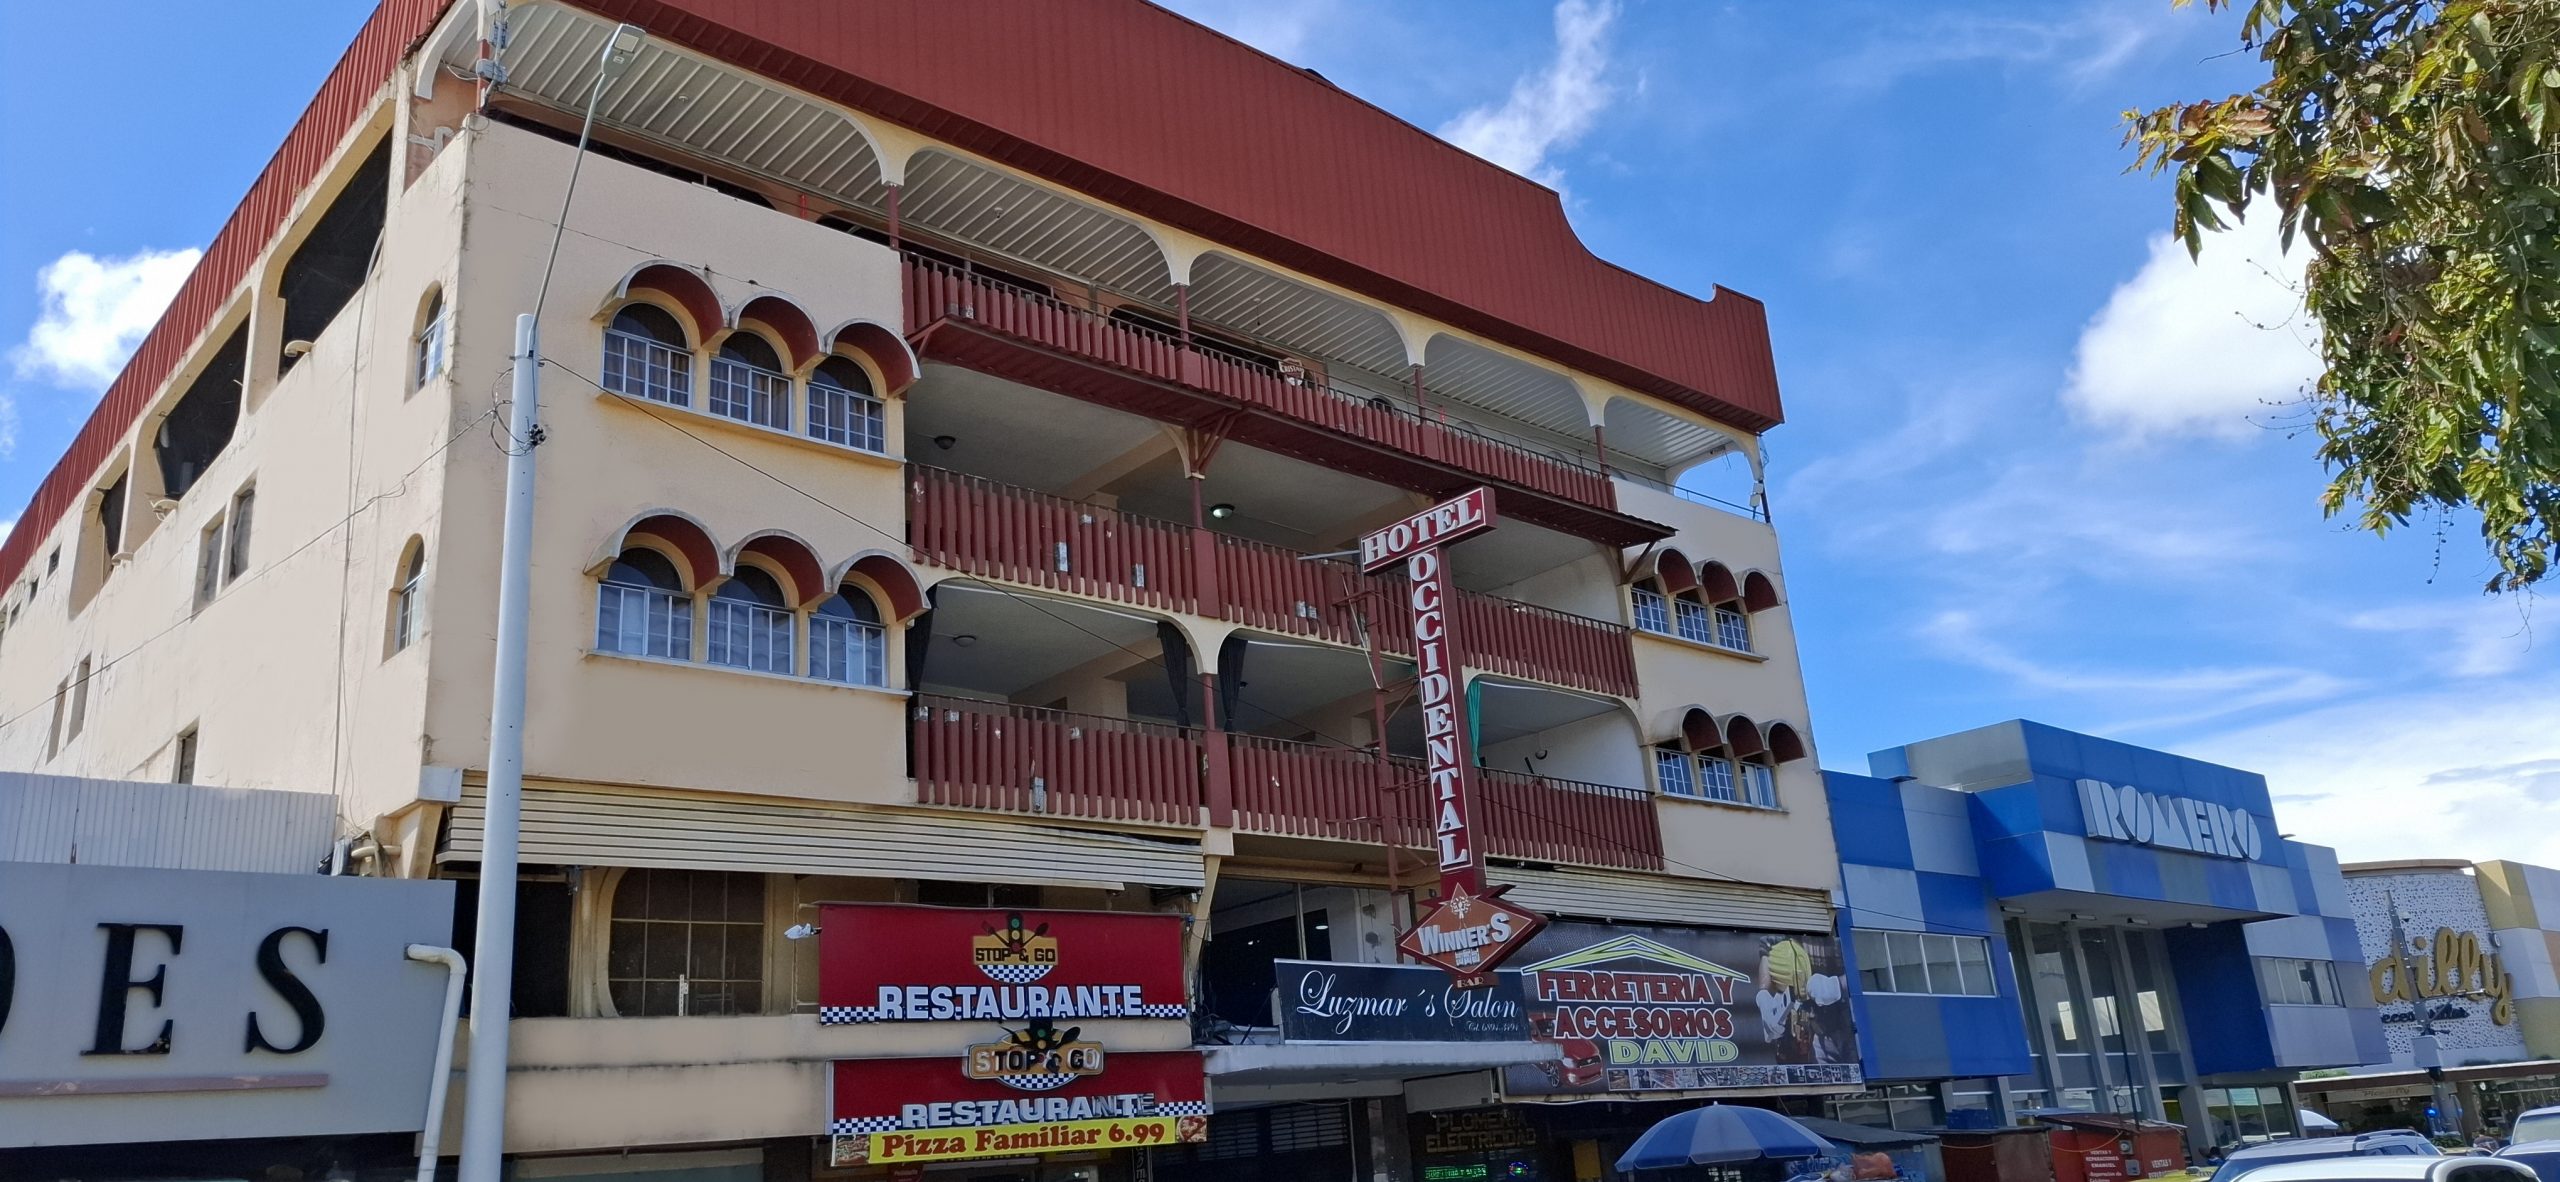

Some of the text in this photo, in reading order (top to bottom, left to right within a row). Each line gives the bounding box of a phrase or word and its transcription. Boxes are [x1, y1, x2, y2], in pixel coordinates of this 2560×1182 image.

[1361, 497, 1481, 565] HOTEL
[1410, 552, 1467, 867] OCCIDENTAL
[2076, 779, 2261, 861] ROMERO
[975, 947, 1056, 963] STOP & GO
[0, 921, 329, 1056] ES
[1456, 976, 1484, 989] BAR
[1537, 970, 1735, 1004] FERRETERIA Y
[877, 985, 1143, 1020] RESTAURANTE
[1297, 970, 1408, 1034] Luzmar
[1444, 984, 1519, 1026] Salon
[1554, 1006, 1735, 1039] ACCESORIOS
[975, 1047, 1036, 1072] STOP
[1067, 1048, 1101, 1071] GO
[1608, 1039, 1739, 1064] DAVID
[902, 1093, 1155, 1130] RESTAURANTE
[881, 1123, 1166, 1158] Pizza Familiar 6.99
